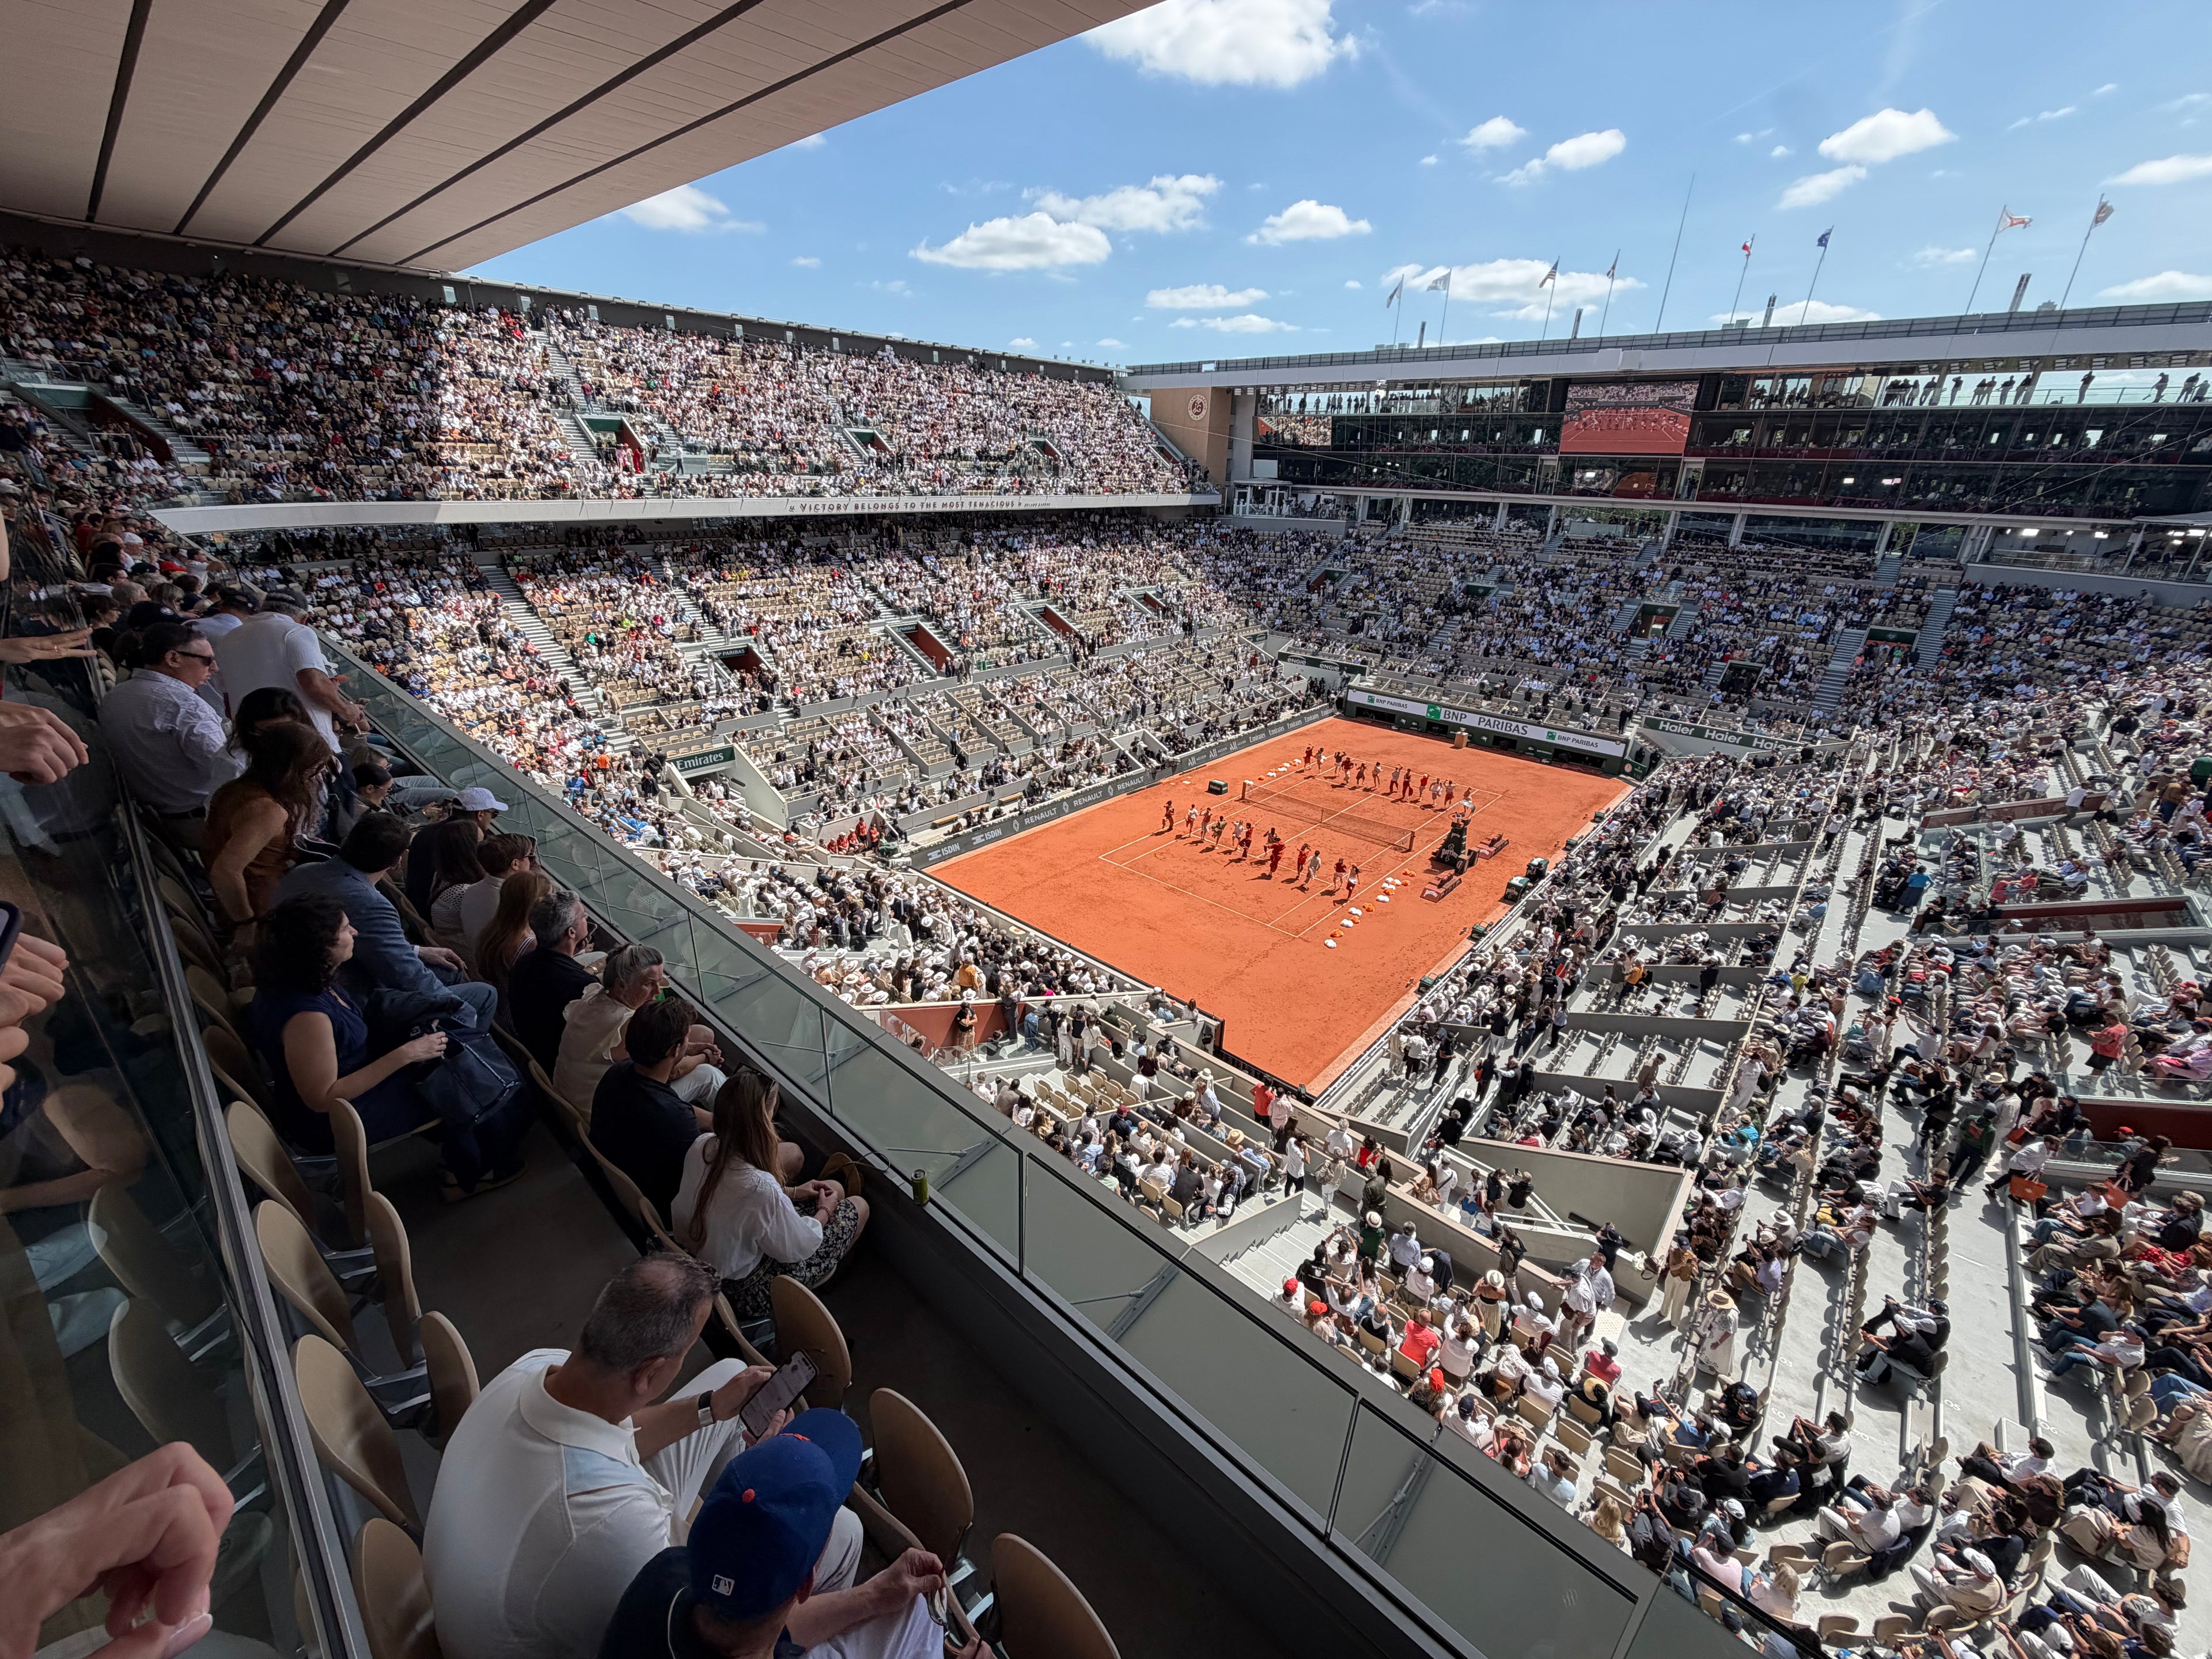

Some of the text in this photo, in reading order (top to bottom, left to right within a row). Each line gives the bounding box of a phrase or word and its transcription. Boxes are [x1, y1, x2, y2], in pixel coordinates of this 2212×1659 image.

[800, 503, 849, 513] VICTORY
[854, 502, 900, 512] BELONGS
[904, 502, 916, 510] TO
[920, 502, 937, 510] THE
[941, 501, 964, 509] MOST
[968, 501, 1014, 509] TENACIOUS
[1387, 700, 1408, 709] PARIBAS
[1304, 713, 1319, 722] Emirates
[1444, 710, 1528, 736] BNP PARIBAS
[1287, 719, 1302, 729] Emirates
[1658, 721, 1695, 735] Haier
[1268, 726, 1285, 736] Emirates
[1705, 729, 1743, 744] Haier
[1249, 732, 1266, 743] Emirates
[1571, 738, 1599, 748] PARIBAS
[676, 752, 724, 770] Emirates
[1118, 776, 1144, 791] RENAULT
[1073, 790, 1103, 806] RENAULT
[1024, 807, 1057, 825] RENAULT
[984, 828, 1002, 840] ISDIN
[941, 843, 960, 856] ISDIN
[1779, 1357, 1793, 1368] 03
[1944, 1399, 1961, 1411] 05
[2040, 1421, 2058, 1434] 06
